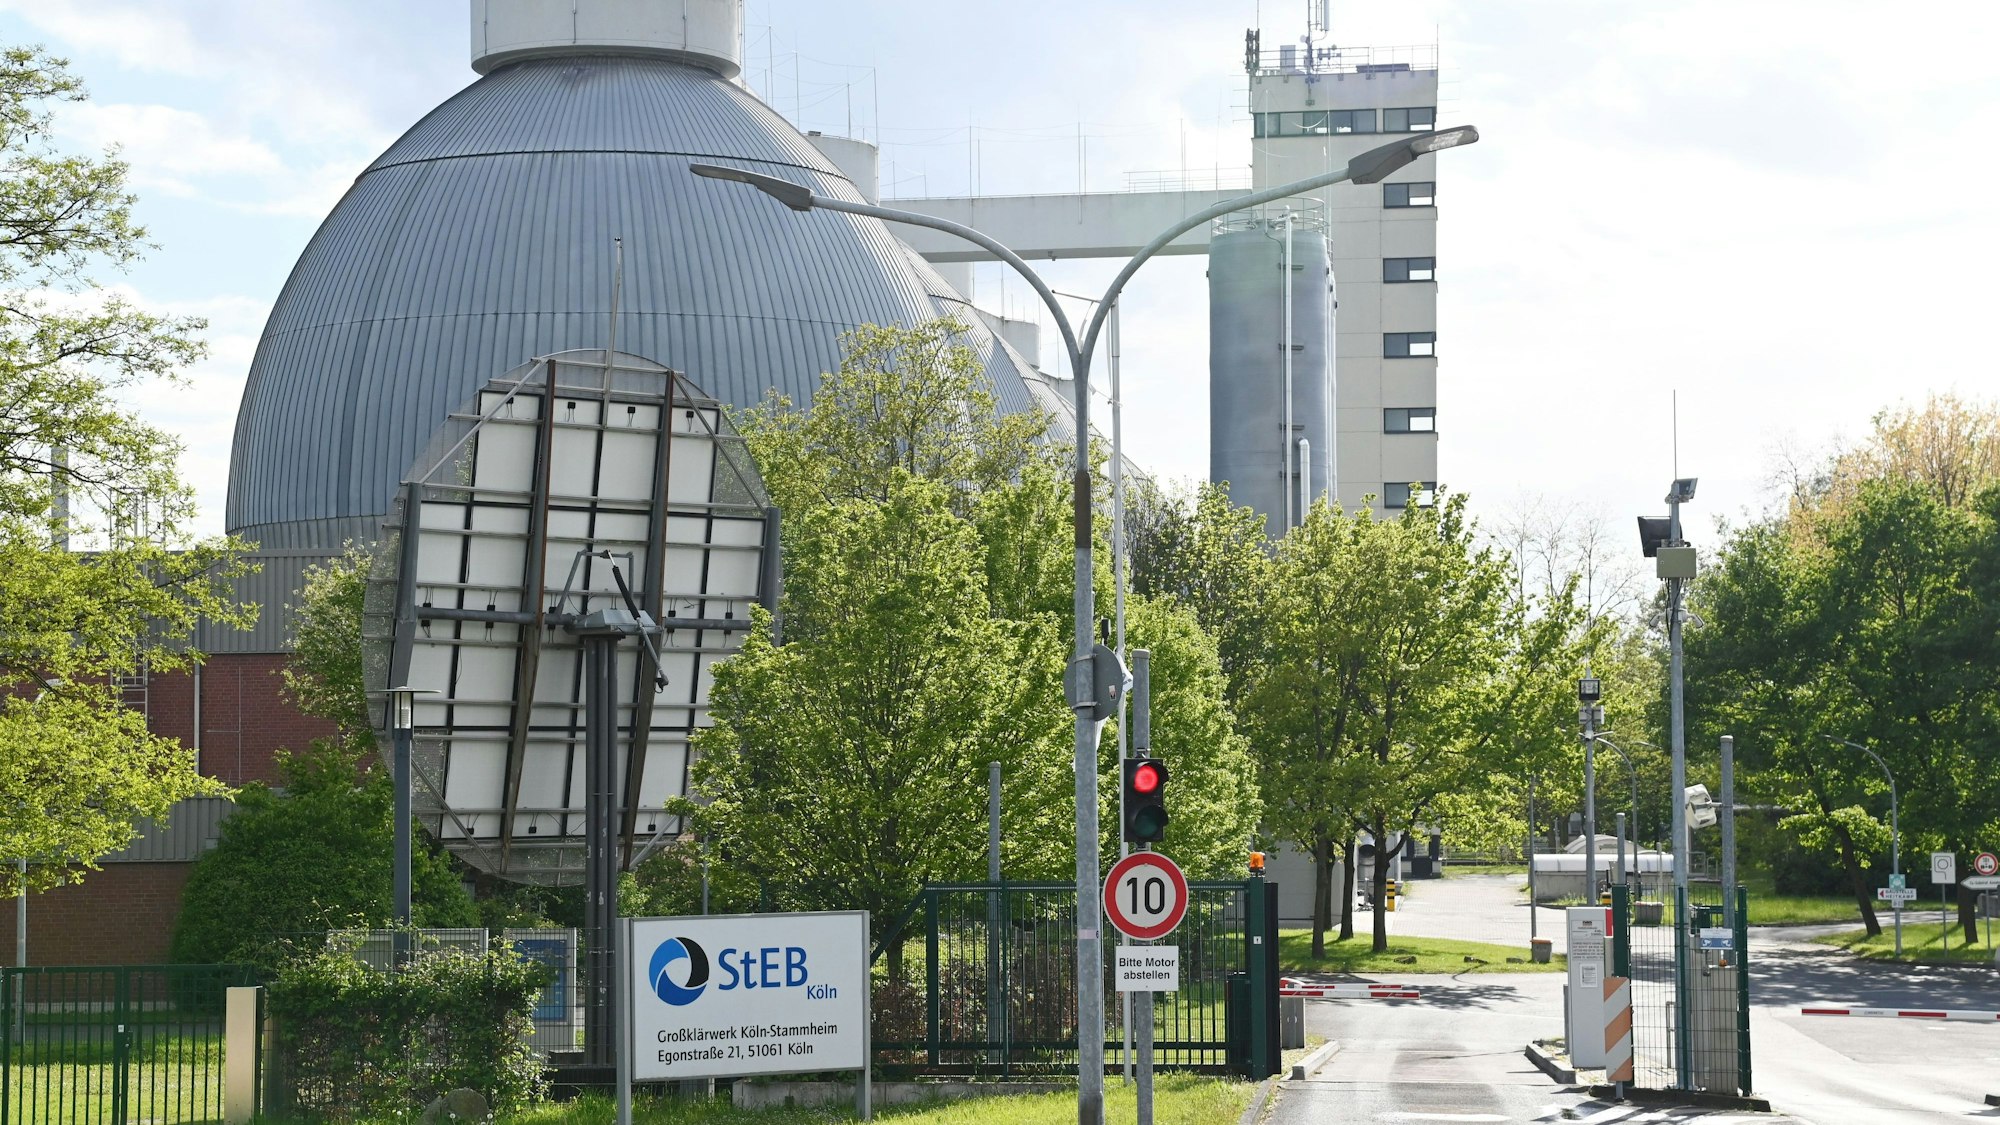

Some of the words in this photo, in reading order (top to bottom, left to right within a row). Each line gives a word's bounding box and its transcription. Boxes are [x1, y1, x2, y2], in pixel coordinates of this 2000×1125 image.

[1127, 877, 1165, 914] 10
[718, 947, 808, 990] StEB
[1119, 957, 1143, 967] Bitte
[1145, 957, 1176, 967] Motor
[1123, 970, 1171, 980] abstellen
[807, 984, 837, 1000] Köln
[657, 1026, 738, 1043] Großklärwerk
[740, 1021, 838, 1039] Köln-Stammheim
[658, 1043, 724, 1065] Egonstraße
[727, 1045, 744, 1060] 21,
[747, 1043, 782, 1058] 51061
[788, 1041, 814, 1056] Köln
